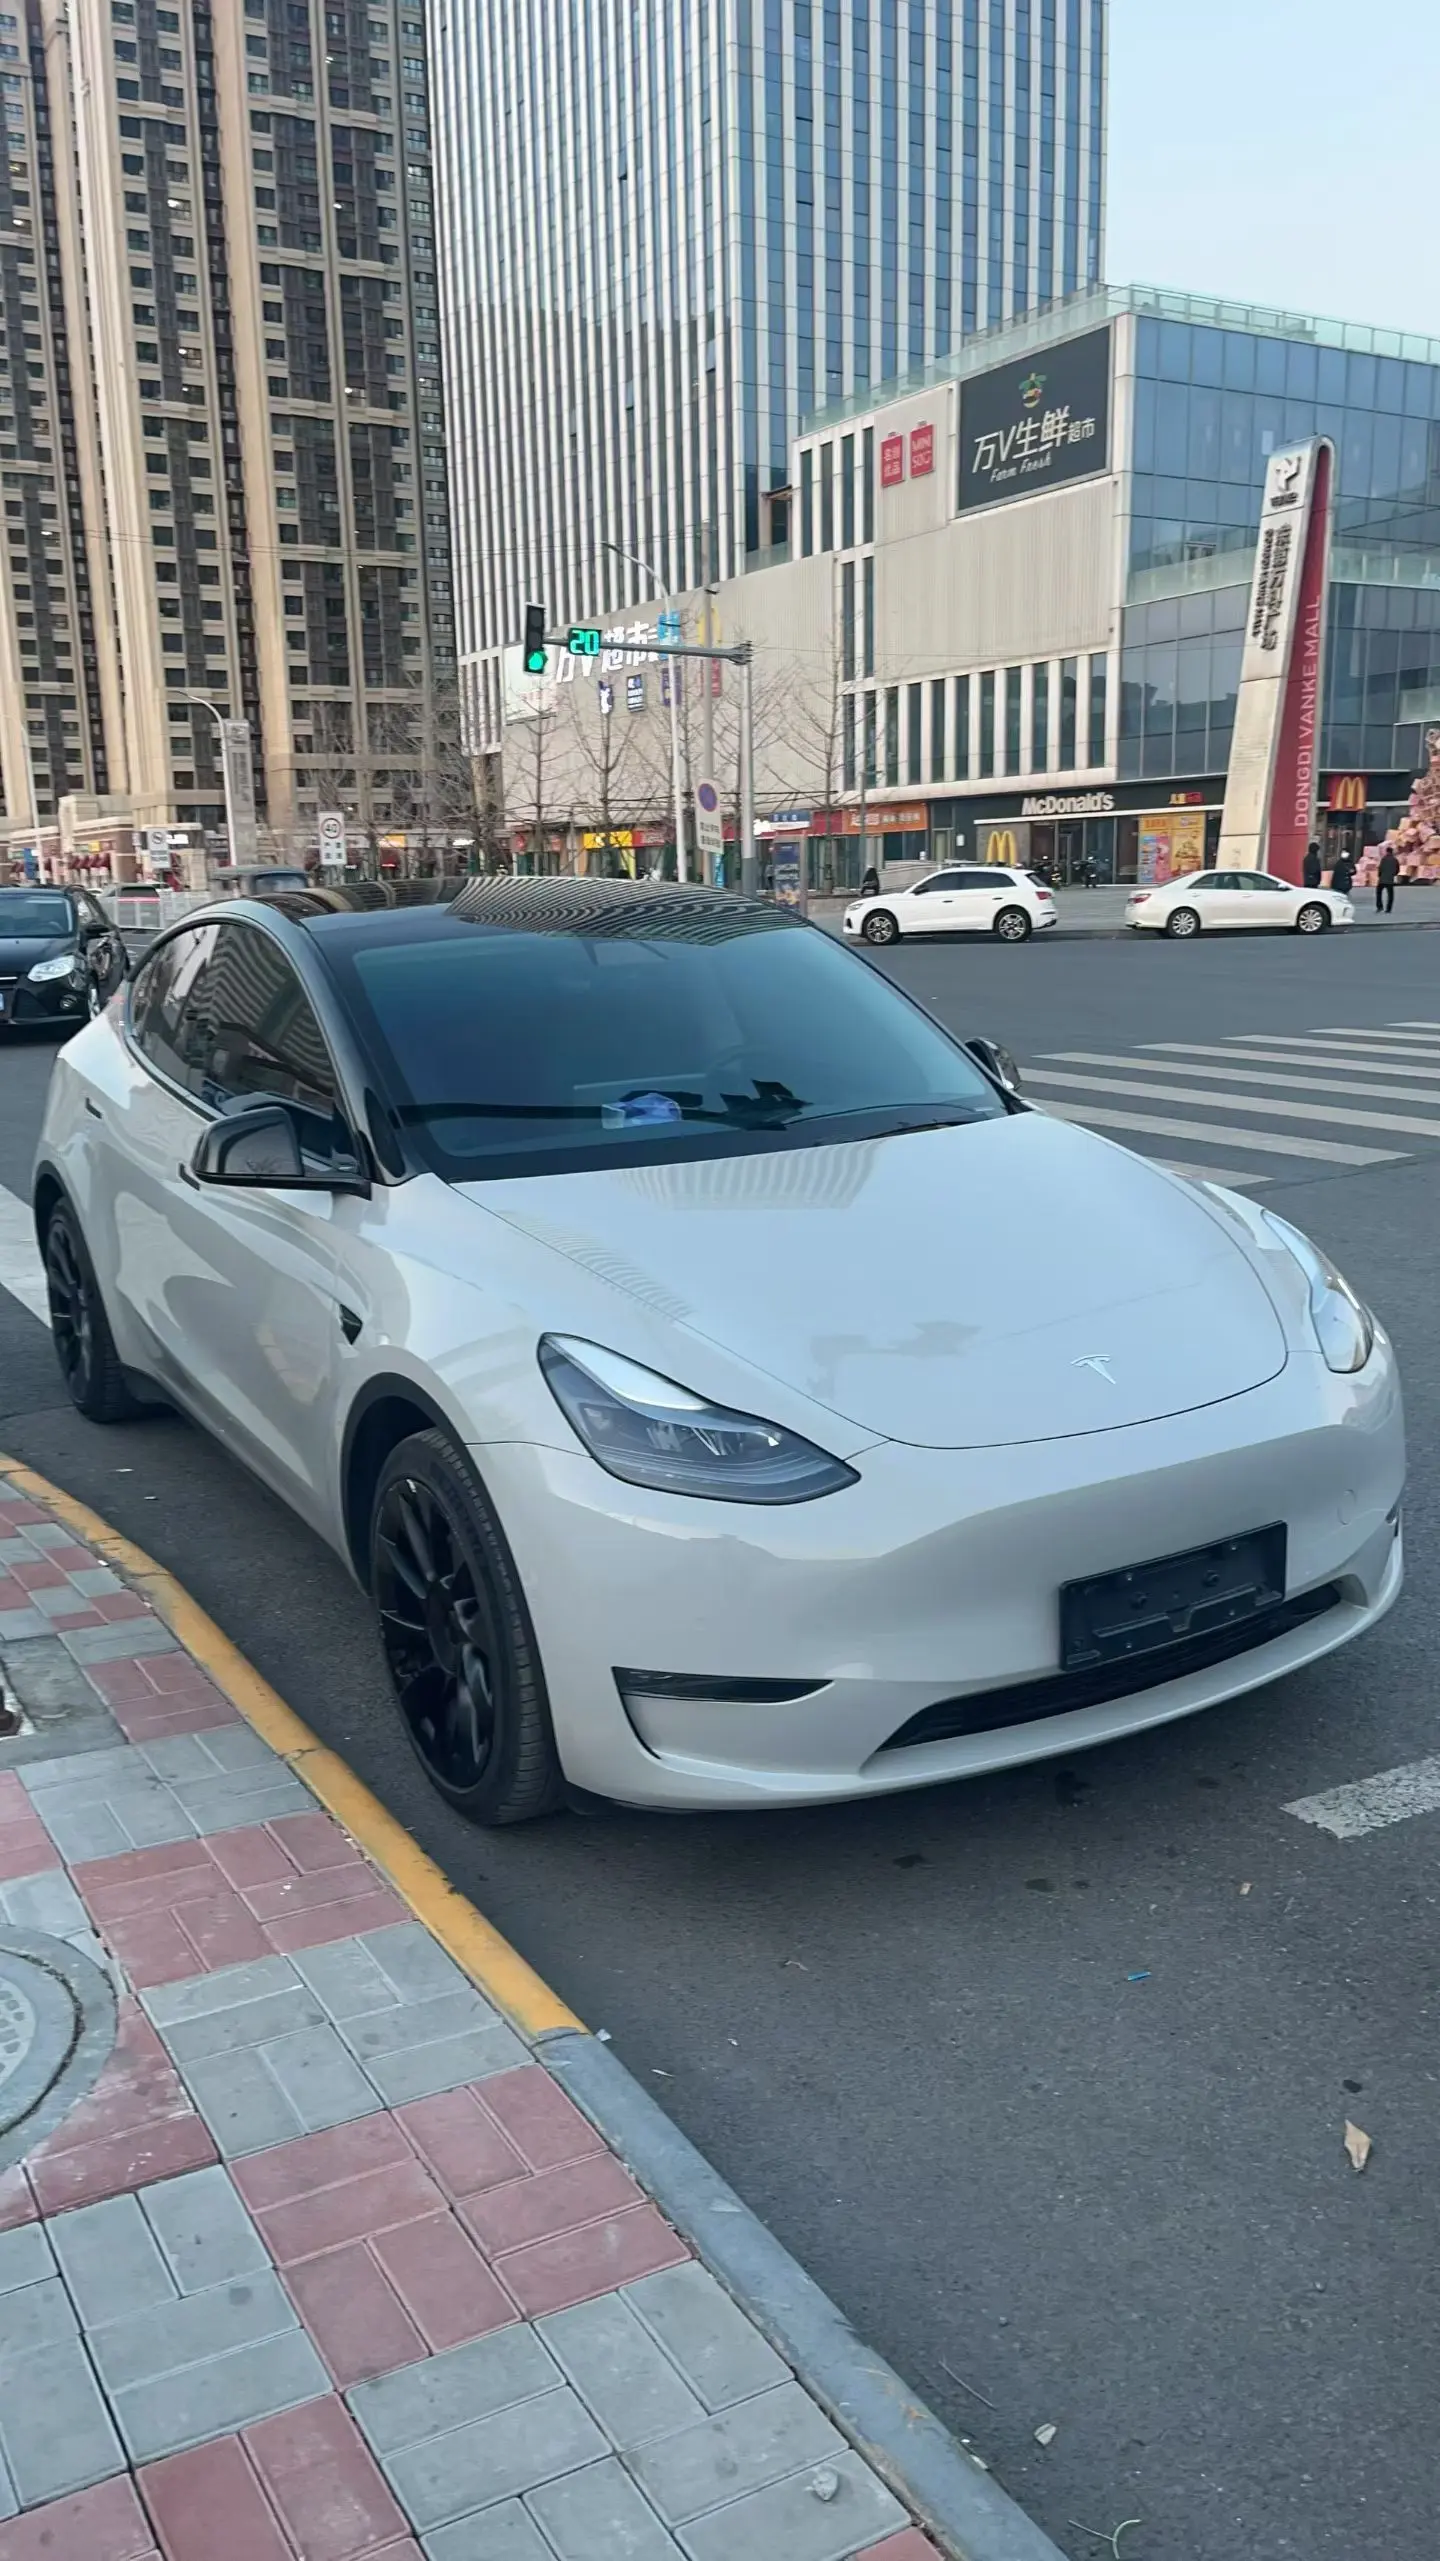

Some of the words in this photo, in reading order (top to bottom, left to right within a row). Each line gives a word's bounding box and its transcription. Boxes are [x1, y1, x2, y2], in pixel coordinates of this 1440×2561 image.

[570, 629, 599, 655] 20
[1303, 594, 1321, 657] MALL
[1299, 663, 1317, 739] VANKE
[1021, 791, 1115, 816] McDonald's
[1294, 744, 1313, 827] DONGDI
